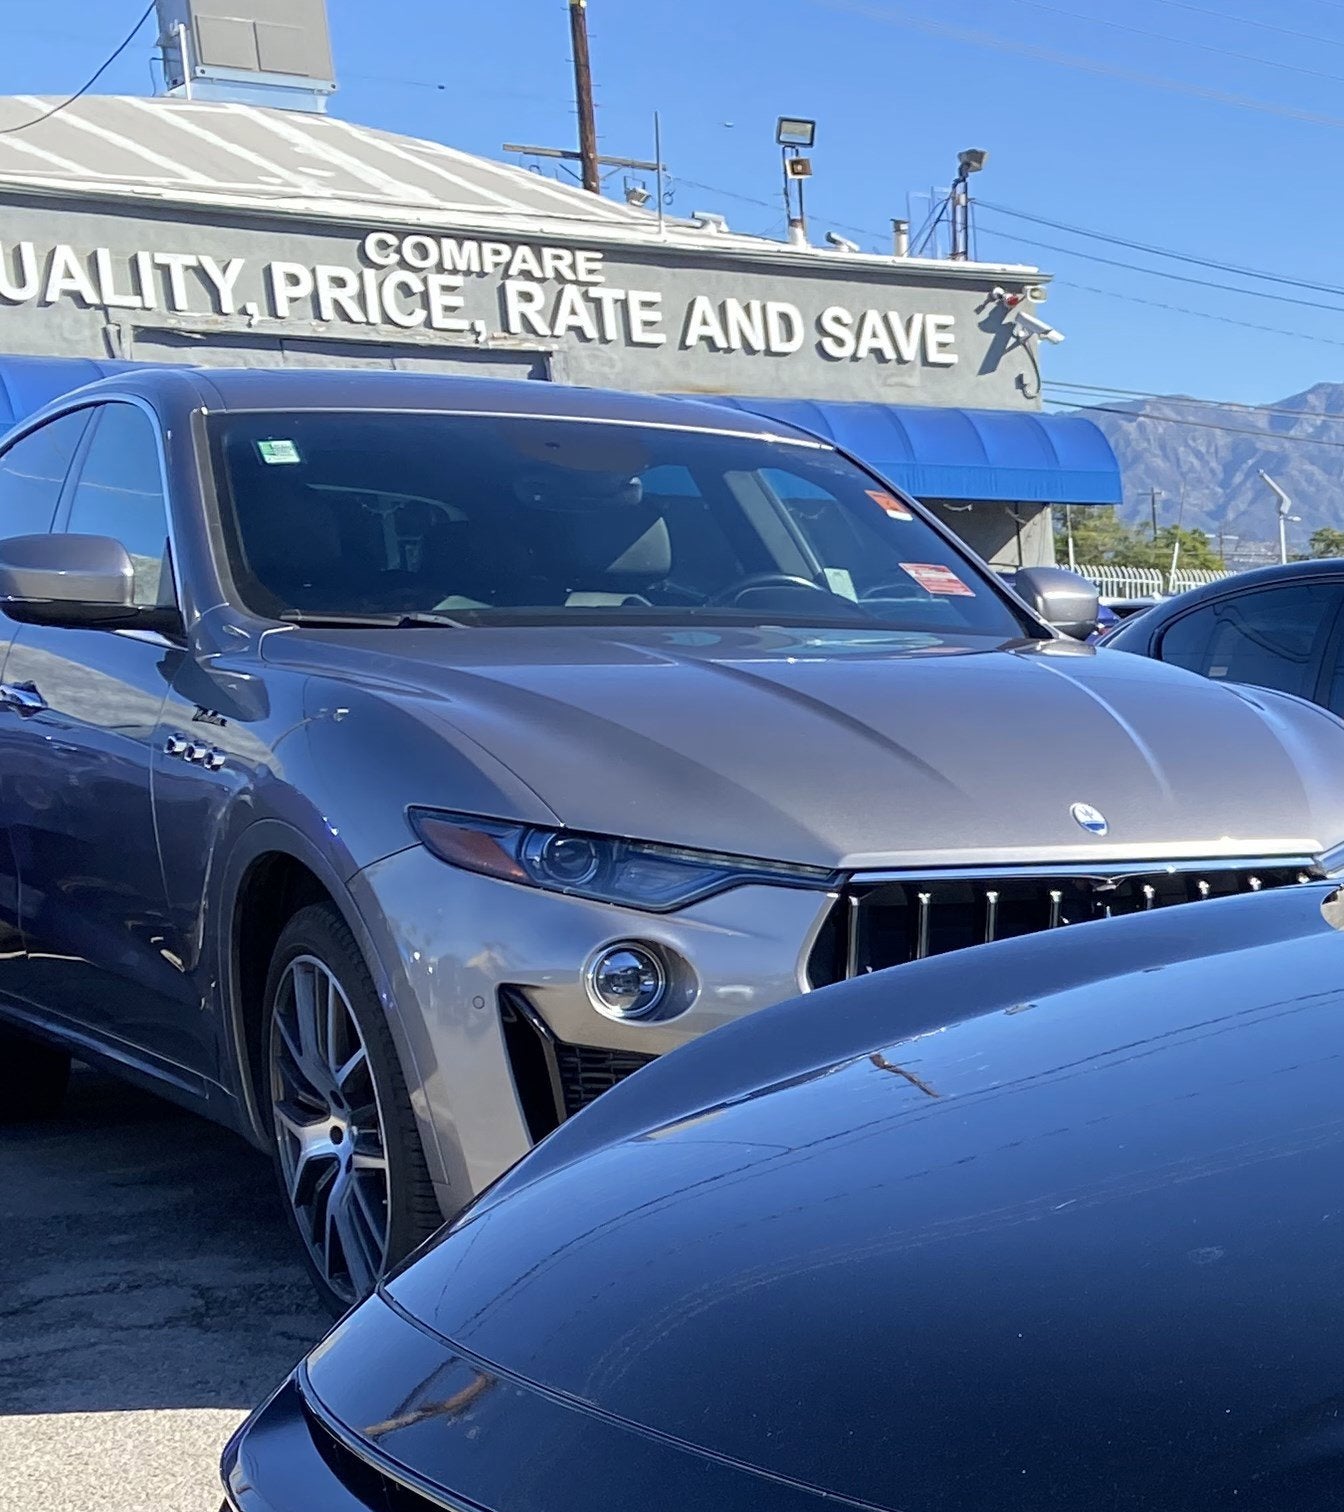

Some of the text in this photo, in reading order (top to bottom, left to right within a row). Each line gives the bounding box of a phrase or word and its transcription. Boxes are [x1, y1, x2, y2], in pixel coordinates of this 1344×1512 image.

[363, 232, 606, 283] COMPARE
[269, 261, 486, 343] PRICE,
[503, 279, 667, 345] RATE
[684, 296, 805, 354] AND
[818, 306, 959, 365] SAVE
